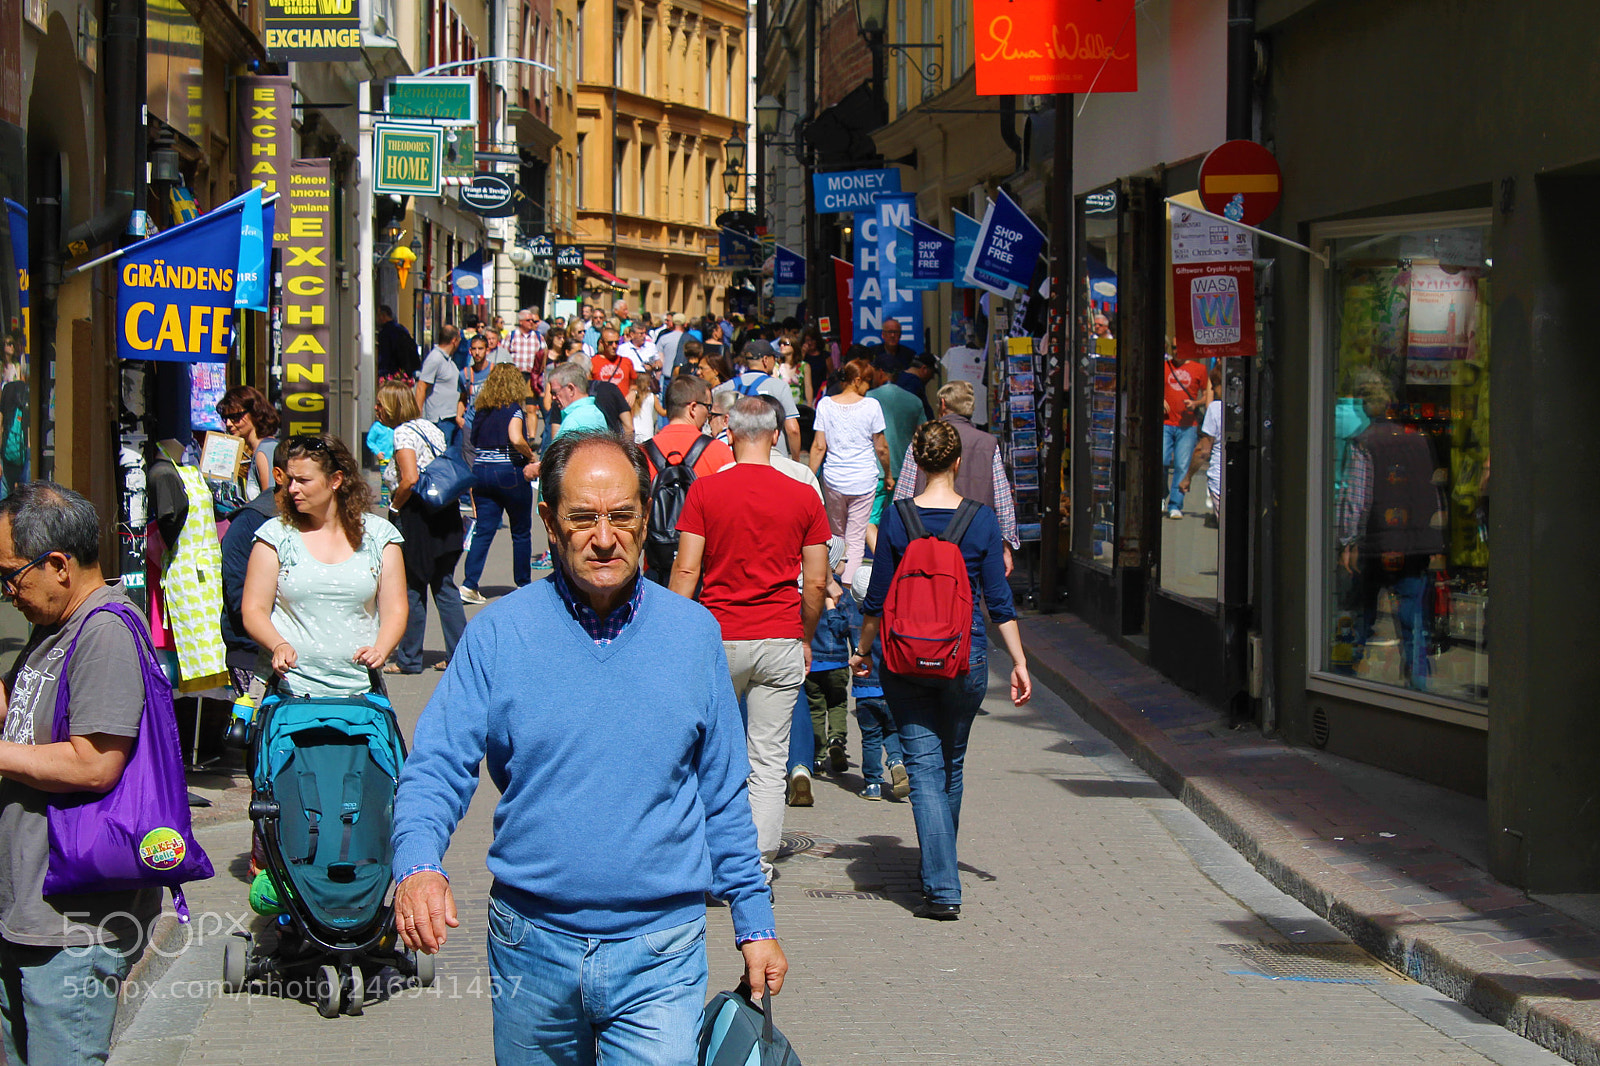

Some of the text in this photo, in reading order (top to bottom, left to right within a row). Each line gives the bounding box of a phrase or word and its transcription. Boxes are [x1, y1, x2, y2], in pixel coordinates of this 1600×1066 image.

[284, 6, 317, 15] UNION
[265, 29, 360, 48] EXCHANGE
[251, 88, 277, 202] EXCHAN
[388, 140, 431, 152] THEODORE'S
[387, 155, 430, 181] HOME
[828, 173, 885, 191] MONEY
[290, 189, 330, 198] алюты
[824, 190, 892, 208] CHAN
[994, 225, 1023, 243] SHOP
[918, 241, 942, 250] SHOP
[992, 236, 1012, 252] TAX
[557, 256, 583, 265] PALACE
[918, 250, 936, 259] TAX
[987, 247, 1014, 264] FREE
[918, 260, 940, 269] FREE
[123, 259, 234, 292] GRÄNDENS
[238, 272, 258, 282] IRS
[1194, 279, 1237, 292] WASA
[124, 301, 232, 355] CAFE
[1195, 329, 1239, 340] CRYSTAL
[153, 850, 175, 862] delic
